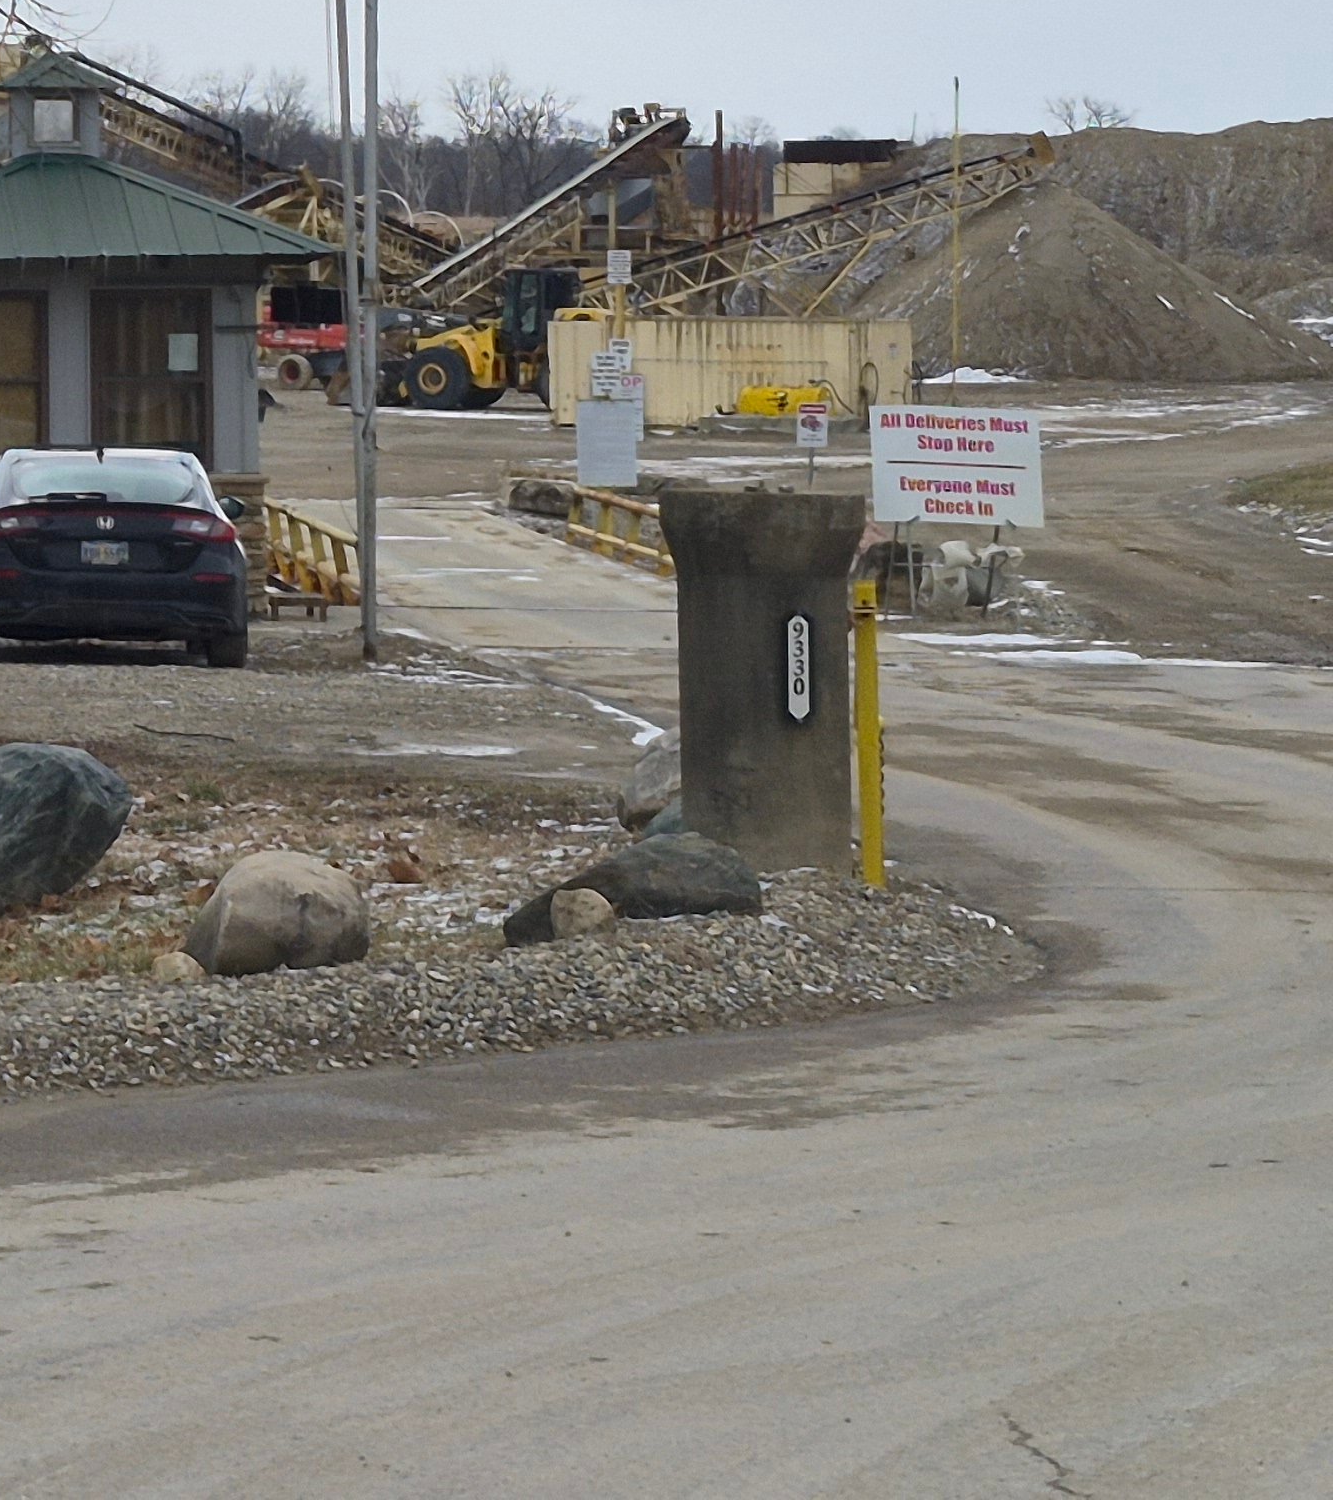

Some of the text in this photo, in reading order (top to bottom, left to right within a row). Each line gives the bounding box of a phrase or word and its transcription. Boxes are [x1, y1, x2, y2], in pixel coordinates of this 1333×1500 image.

[620, 376, 642, 388] OP
[881, 413, 1029, 433] All Deliveries Must
[917, 435, 995, 453] Stop Here
[899, 476, 1016, 496] Everyone Must
[924, 498, 994, 516] Check In
[792, 621, 806, 696] 9330
